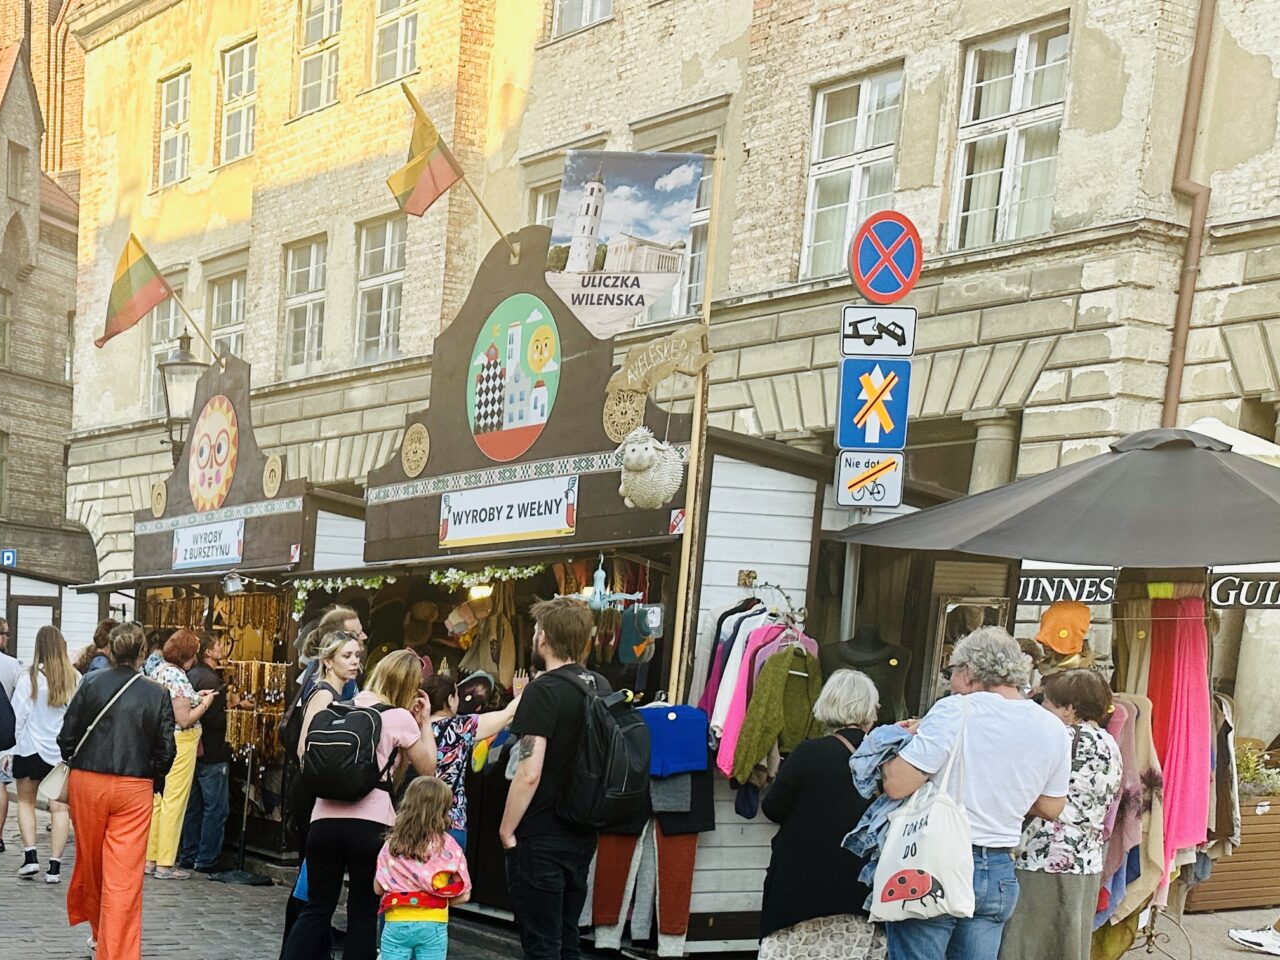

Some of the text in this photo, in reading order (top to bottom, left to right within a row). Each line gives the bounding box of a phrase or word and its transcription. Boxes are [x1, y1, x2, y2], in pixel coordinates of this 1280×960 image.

[580, 275, 641, 289] ULICZKA
[570, 293, 646, 307] WILENSKA
[845, 457, 861, 469] Nie
[451, 497, 563, 526] WYROBY Z WEŁNY
[192, 529, 223, 545] WYROBY
[183, 543, 230, 561] Z BURSZTYNU
[1017, 577, 1116, 602] INNES
[1210, 576, 1280, 606] GUI
[902, 842, 917, 859] DO
